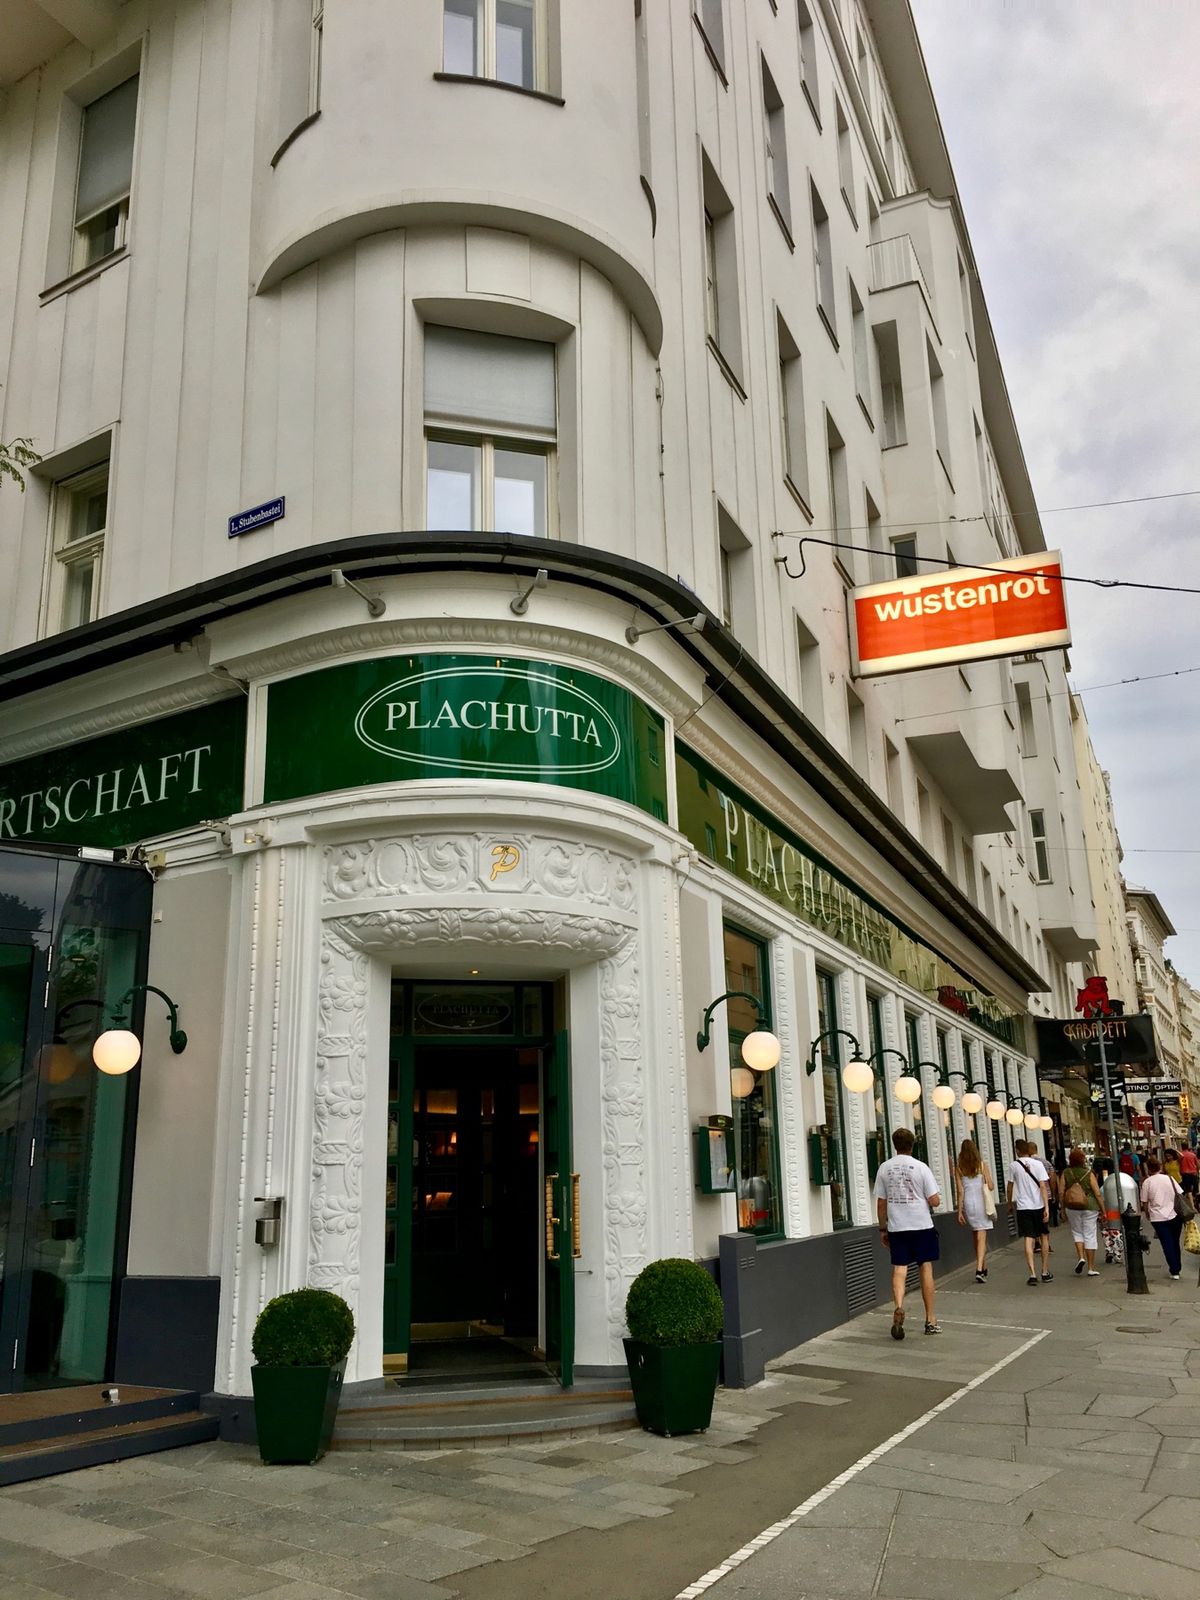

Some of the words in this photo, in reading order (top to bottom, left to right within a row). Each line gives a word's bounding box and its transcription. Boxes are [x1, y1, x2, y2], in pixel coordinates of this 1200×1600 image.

[239, 503, 281, 528] Stubenbastei
[385, 699, 603, 749] PLACHUTTA
[0, 744, 212, 839] RTSCHAFT
[723, 795, 871, 951] PLACHUTTA
[1154, 1083, 1180, 1091] OPTIK
